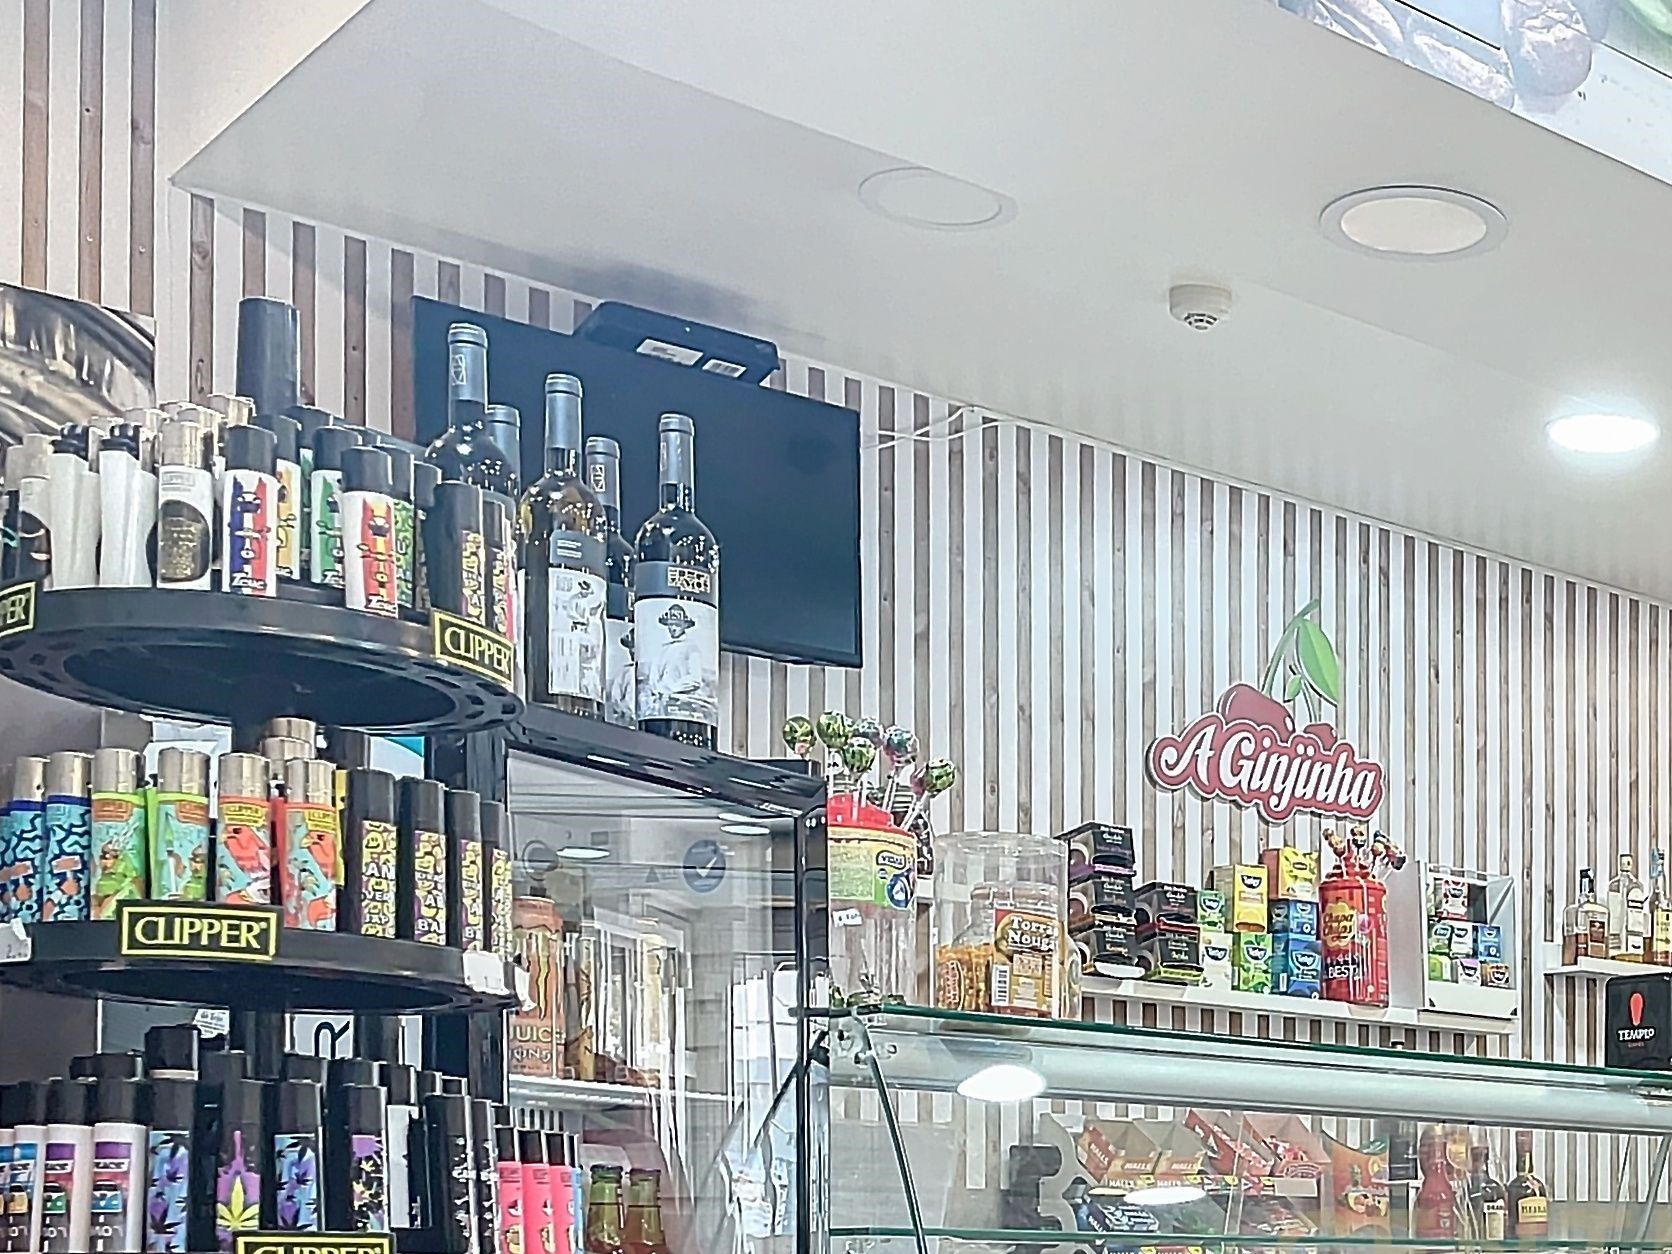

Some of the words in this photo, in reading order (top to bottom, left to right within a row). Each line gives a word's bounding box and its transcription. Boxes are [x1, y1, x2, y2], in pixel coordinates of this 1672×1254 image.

[444, 626, 511, 675] CLIPPER
[1160, 723, 1217, 787] A
[1219, 731, 1377, 812] Ginjinha
[134, 916, 262, 949] CLIPPER
[1618, 1027, 1655, 1042] TEMPLO
